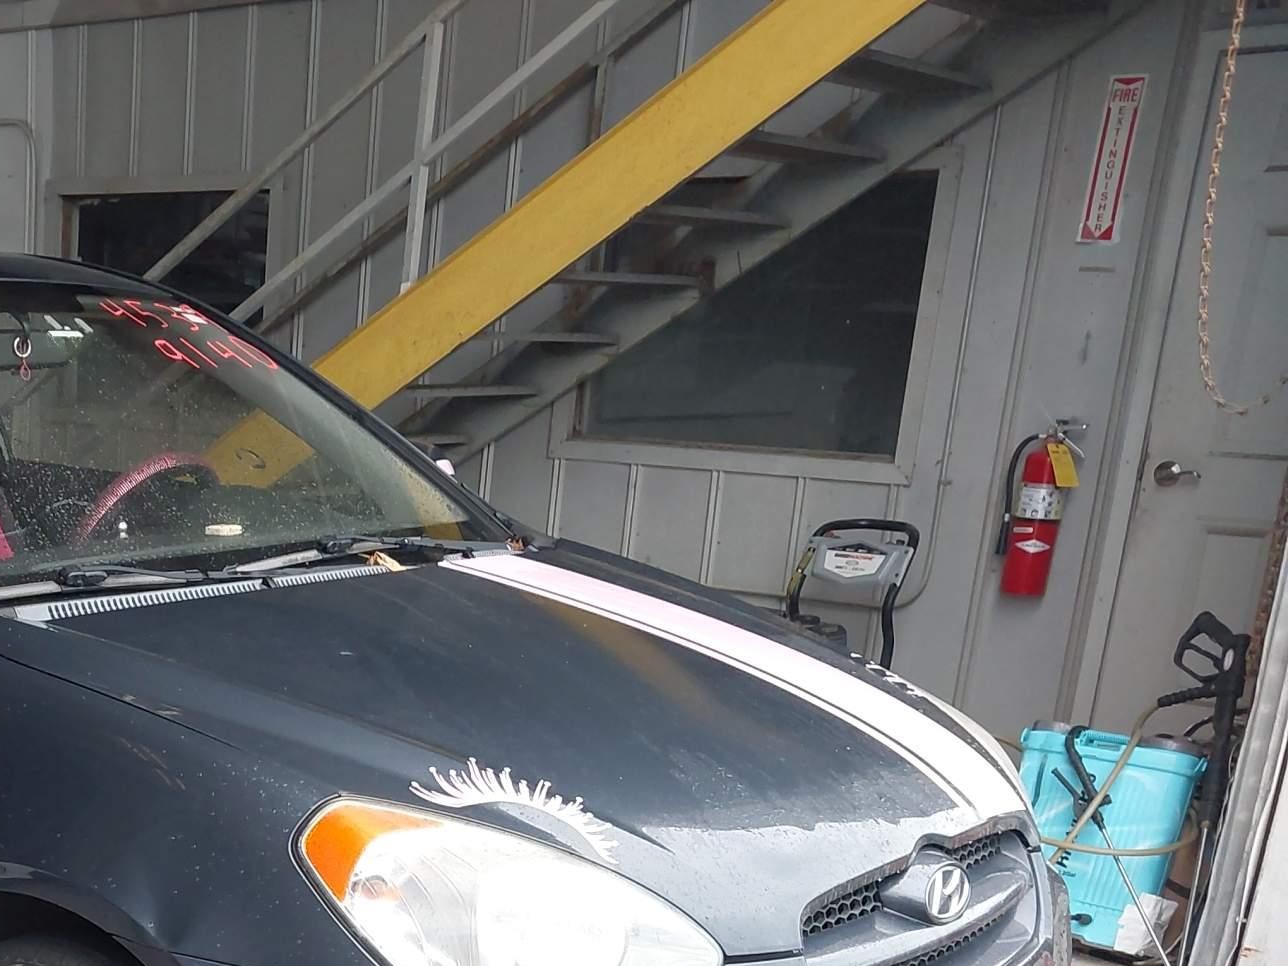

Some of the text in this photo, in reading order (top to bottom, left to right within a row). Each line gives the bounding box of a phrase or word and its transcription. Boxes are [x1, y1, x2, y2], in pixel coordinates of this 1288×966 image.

[1112, 87, 1139, 104] FIRE
[1094, 105, 1127, 232] EXTINGUISHER
[154, 335, 279, 370] 9140
